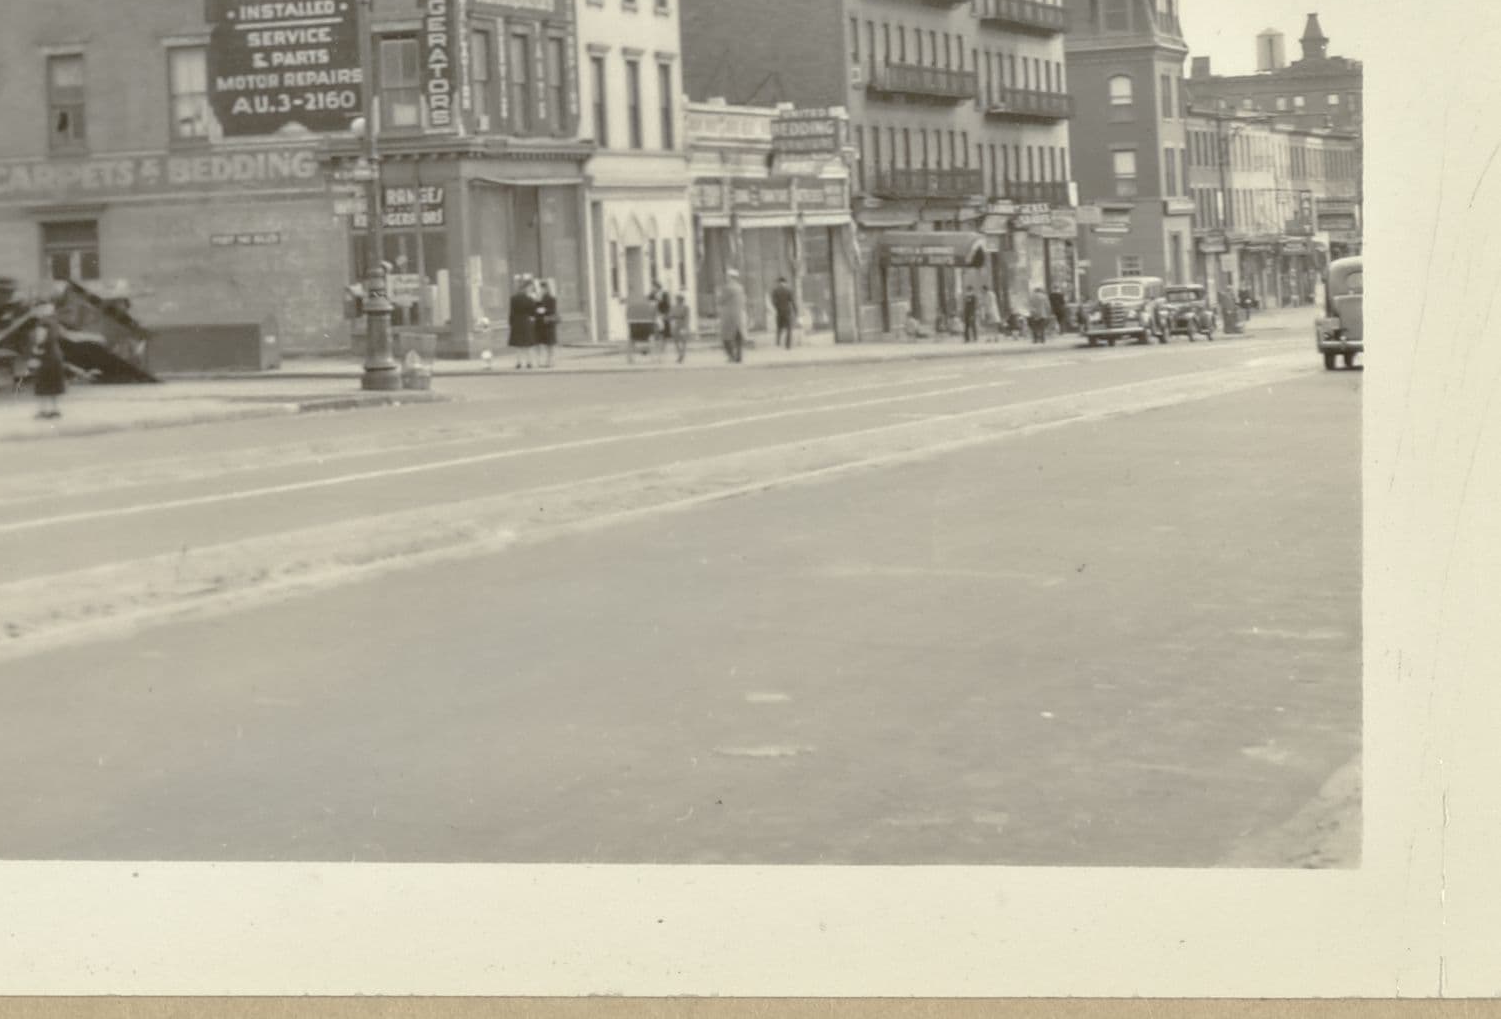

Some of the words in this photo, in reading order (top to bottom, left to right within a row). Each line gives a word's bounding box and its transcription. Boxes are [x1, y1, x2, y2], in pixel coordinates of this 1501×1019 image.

[239, 0, 335, 21] INSTALLED
[247, 28, 332, 48] SERVICE
[253, 52, 269, 69] &
[272, 49, 330, 67] PARTS
[216, 74, 280, 91] MOTOR
[283, 68, 363, 87] REPAIRS
[168, 150, 319, 183] BEDDING
